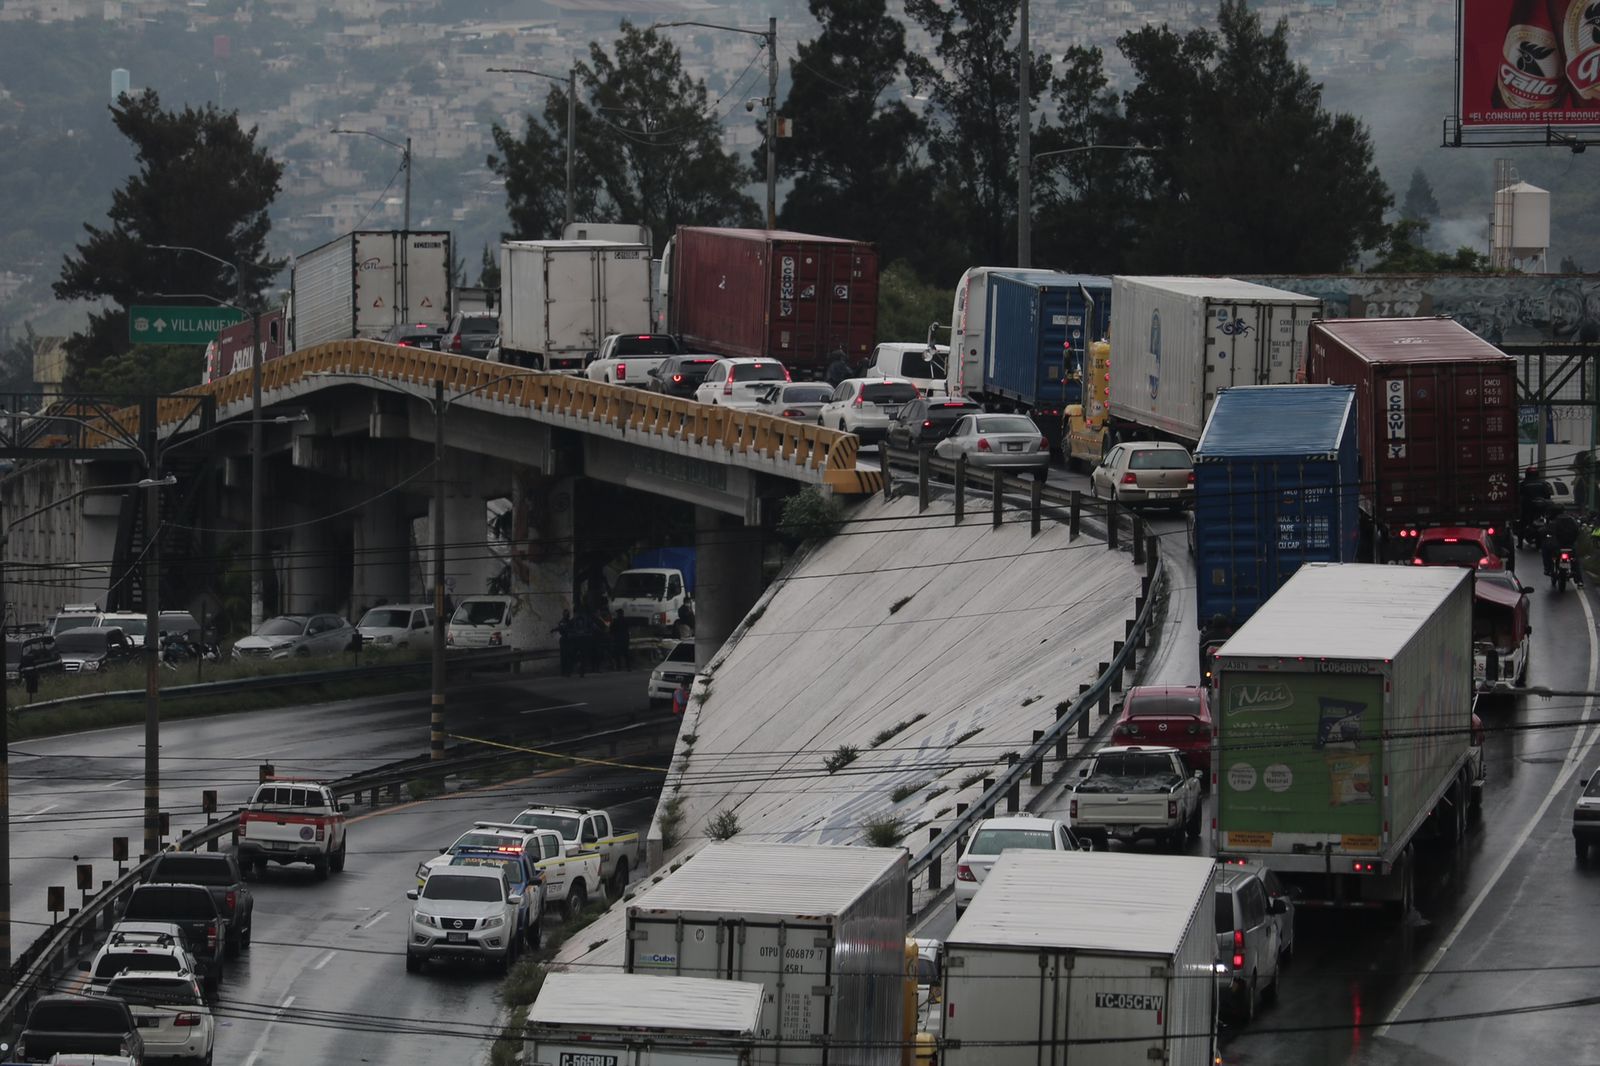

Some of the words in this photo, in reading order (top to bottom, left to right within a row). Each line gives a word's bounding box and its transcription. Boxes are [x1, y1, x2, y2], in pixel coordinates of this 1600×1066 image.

[1486, 112, 1527, 120] CONSUMO
[1530, 112, 1540, 120] DE
[1543, 112, 1563, 120] ESTE
[1389, 395, 1404, 457] CROWLY
[785, 948, 815, 959] 606879
[1097, 993, 1161, 1010] TC-05CFW
